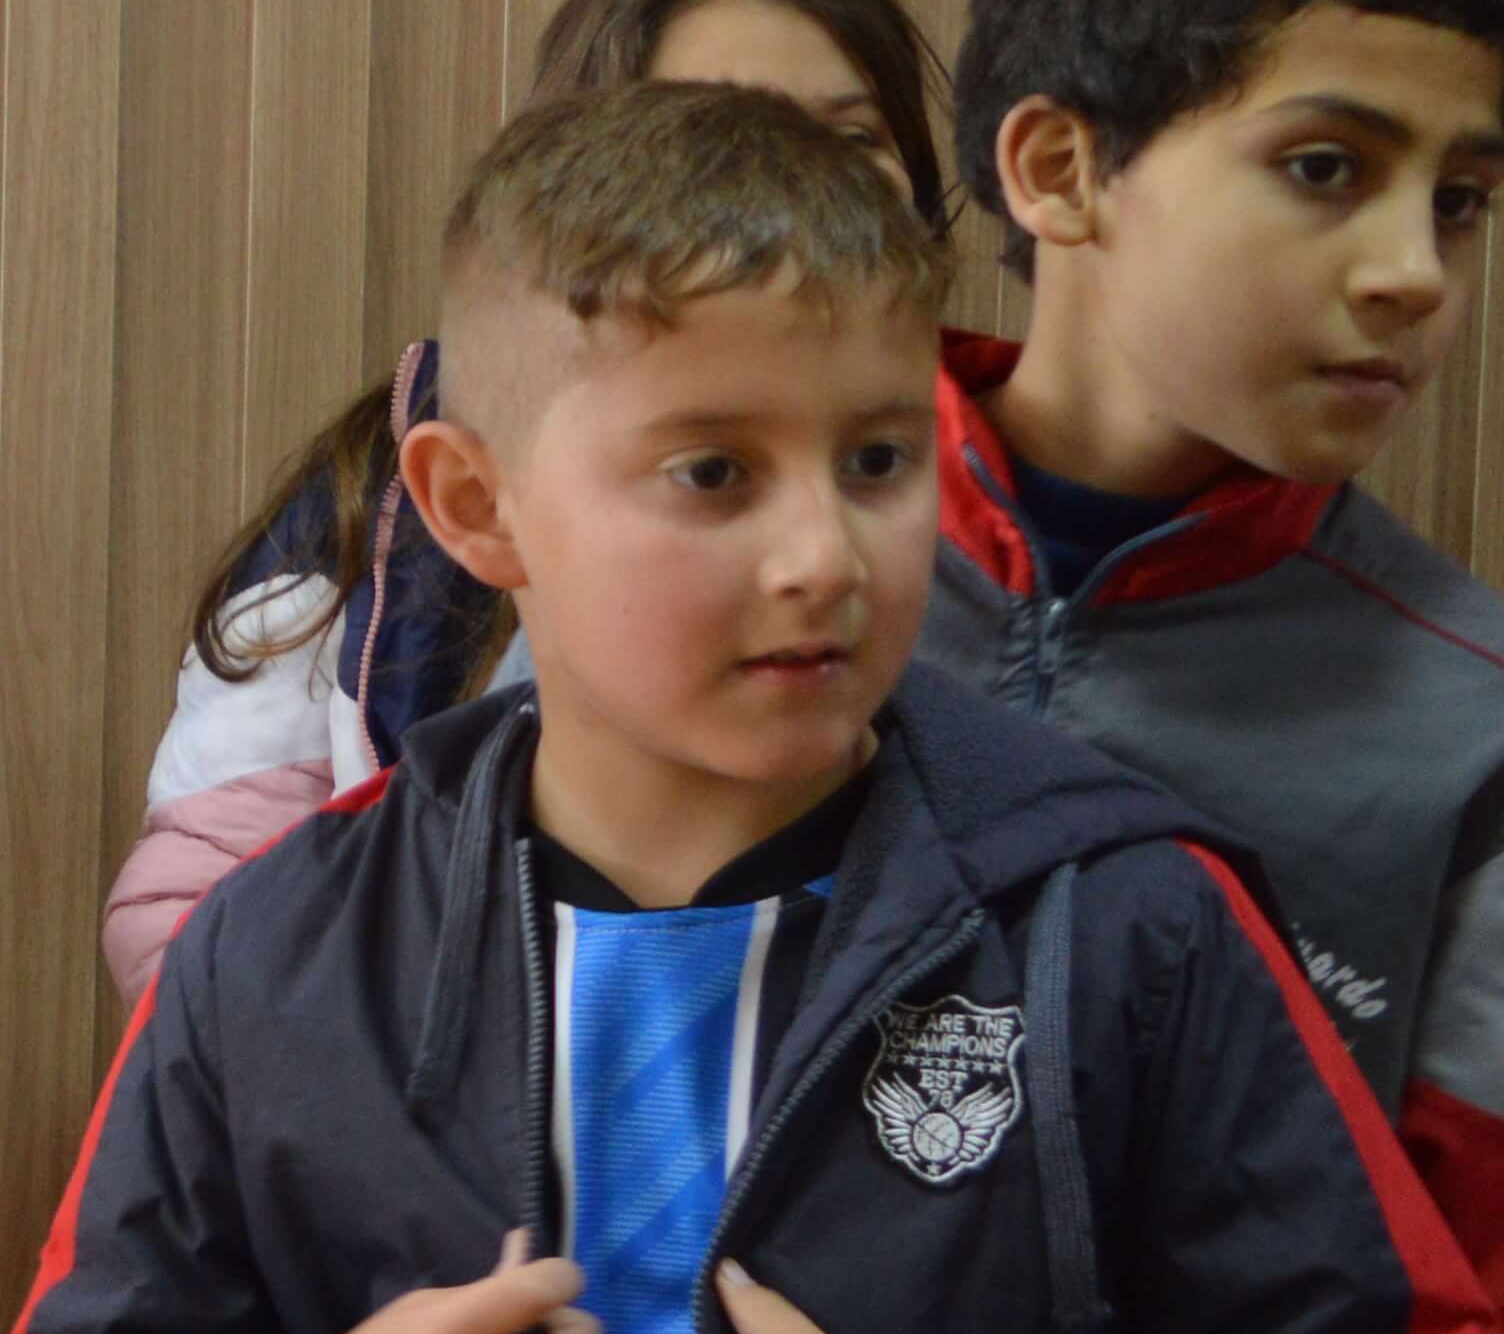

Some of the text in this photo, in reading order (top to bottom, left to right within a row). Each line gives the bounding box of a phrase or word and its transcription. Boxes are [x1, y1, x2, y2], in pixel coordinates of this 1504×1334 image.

[923, 1013, 965, 1032] ARE
[968, 1015, 1014, 1037] THE
[889, 1031, 1006, 1058] CHAMPIONS
[918, 1068, 968, 1091] EST
[928, 1089, 955, 1108] 78
